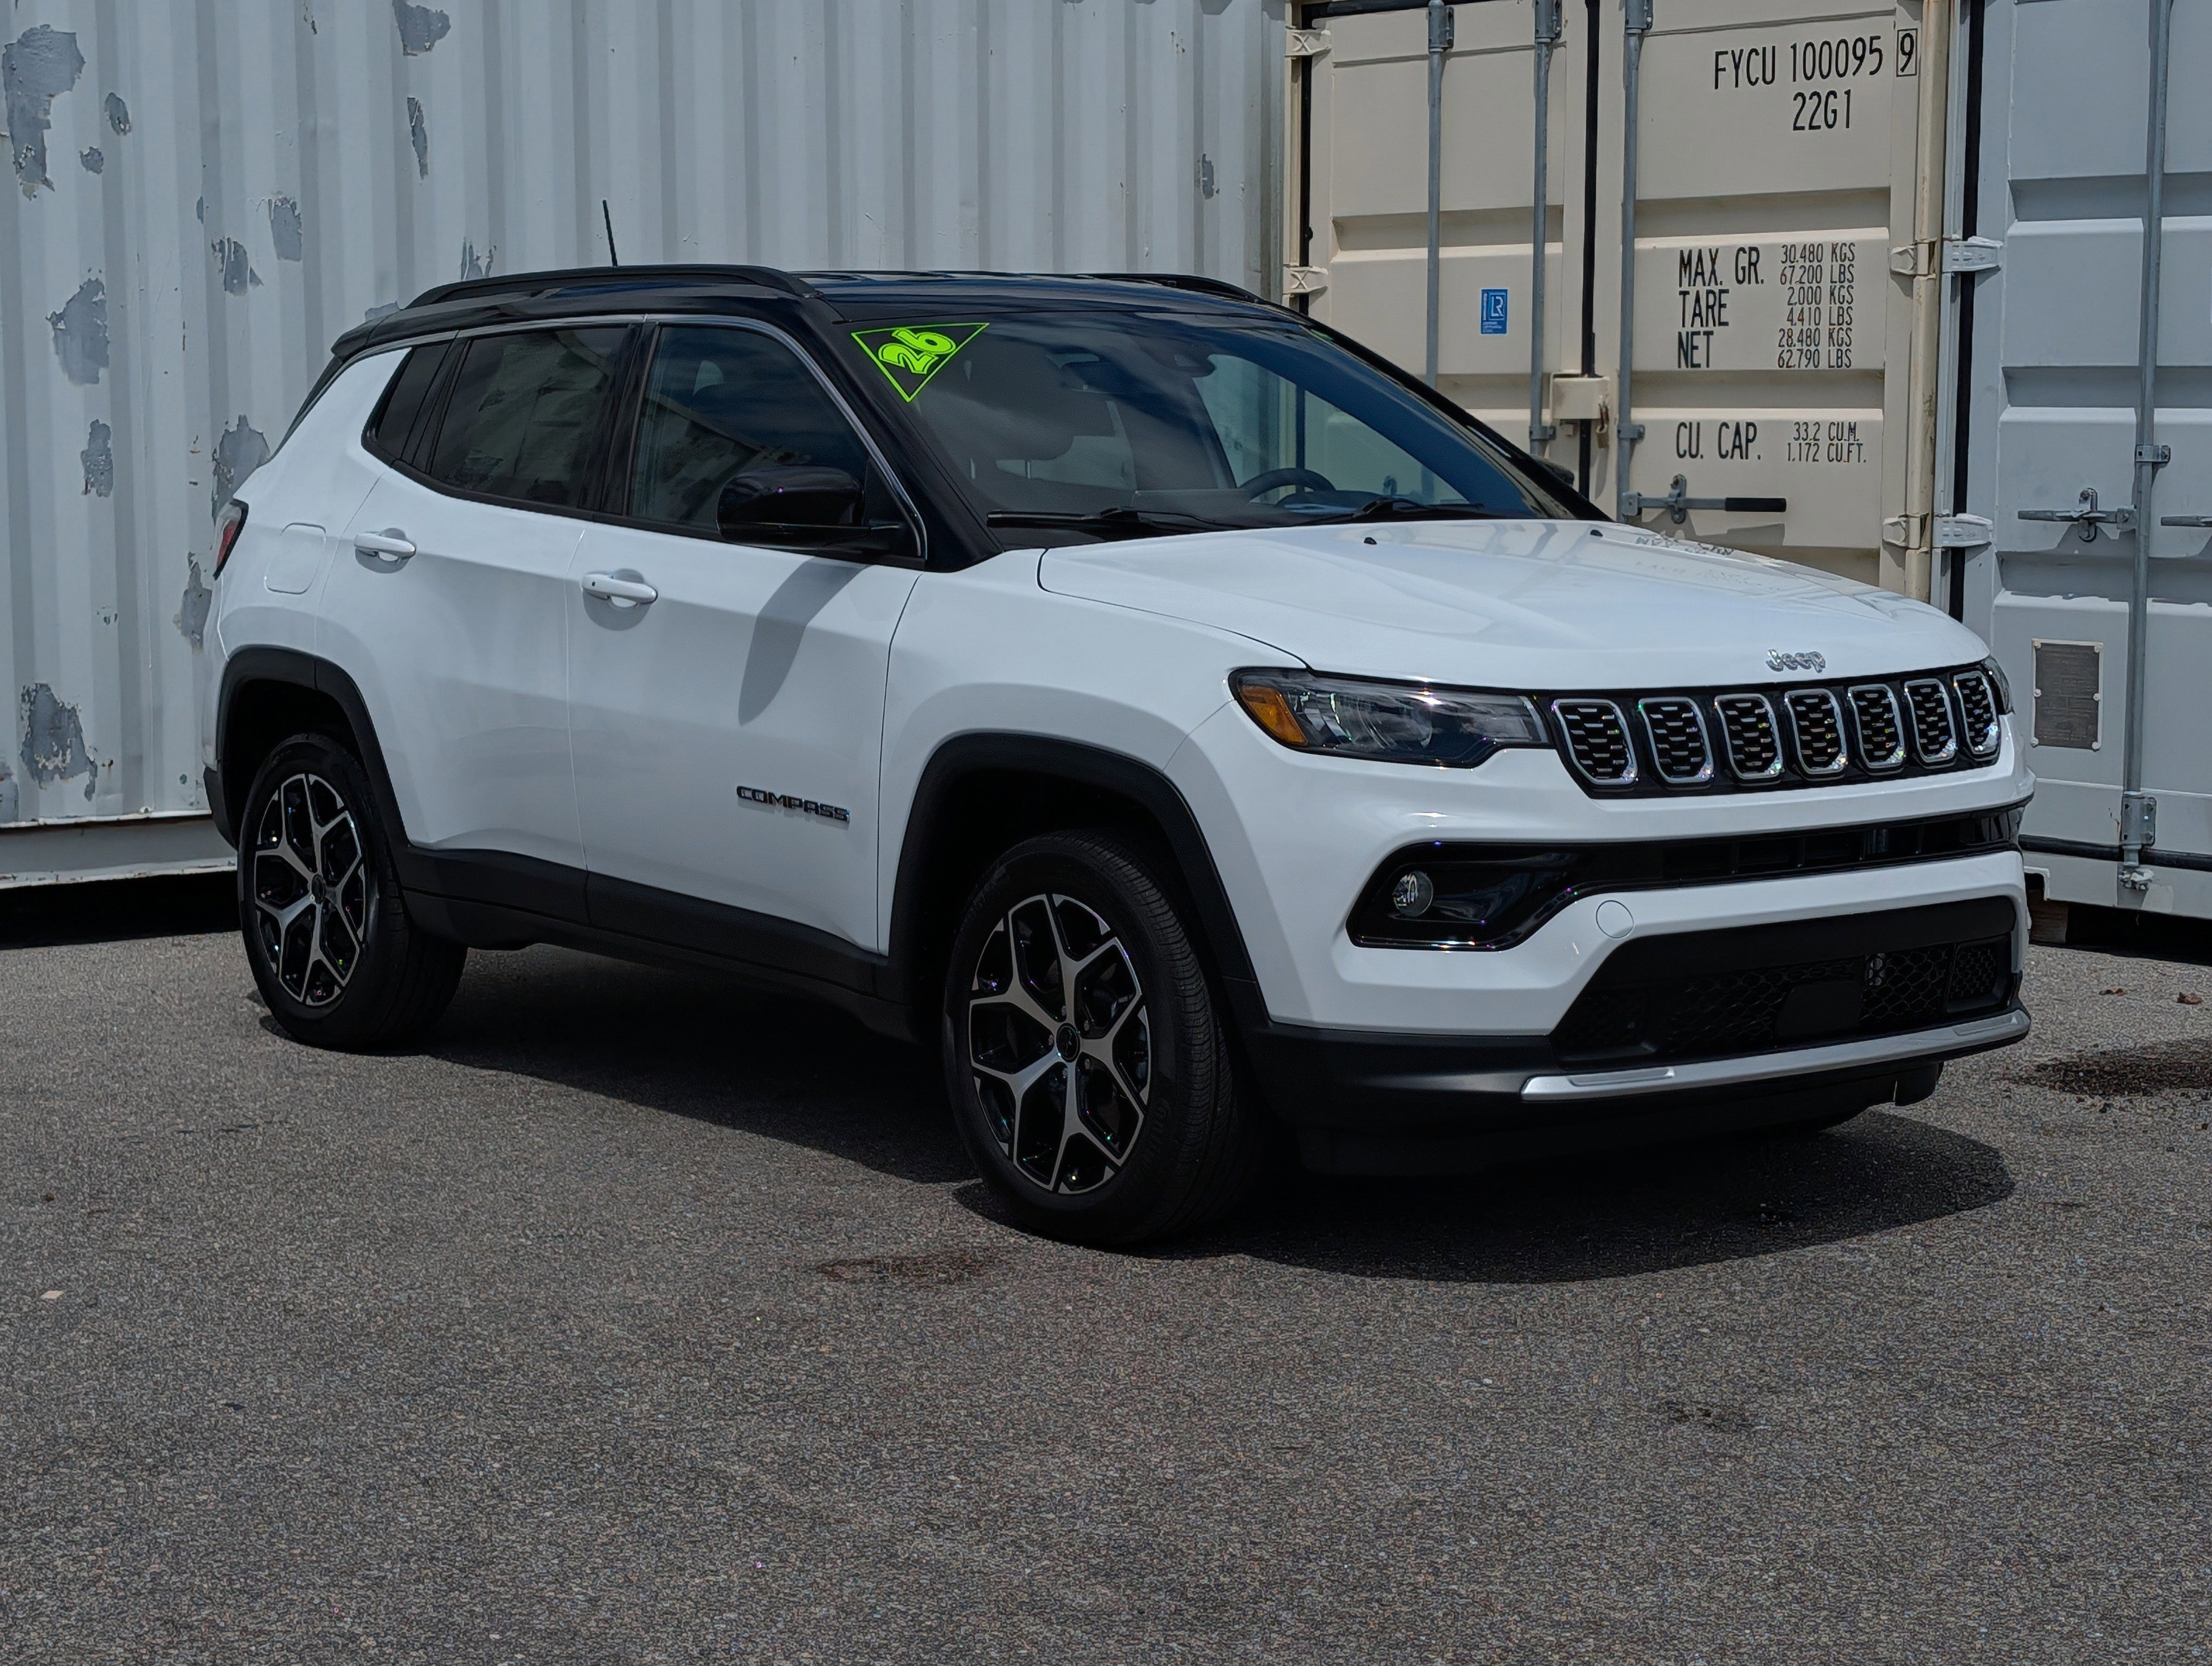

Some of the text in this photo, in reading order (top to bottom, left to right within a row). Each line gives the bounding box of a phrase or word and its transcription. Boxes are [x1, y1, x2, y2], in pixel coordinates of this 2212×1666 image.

[1715, 33, 1914, 89] FYCU 100095 9
[1793, 89, 1851, 131] 22G1
[1780, 242, 1855, 264] 30.480 KGS
[1679, 246, 1764, 287] MAX. GR.
[1780, 264, 1854, 285] 67.200 LBS
[1787, 285, 1854, 306] 2.000 KGS
[1679, 289, 1729, 328] TARE
[1786, 306, 1853, 326] 4.410 LBS
[1677, 330, 1714, 369] NET
[1778, 327, 1852, 348] 28.480 KGS
[878, 328, 956, 374] 26
[1778, 348, 1852, 368] 62.790 LBS
[1676, 421, 1761, 460] CU. CAP.
[1793, 421, 1821, 441] 33.2
[1787, 443, 1820, 462] 1.172
[1766, 649, 1826, 673] Jeep
[736, 786, 850, 822] COMPASS
